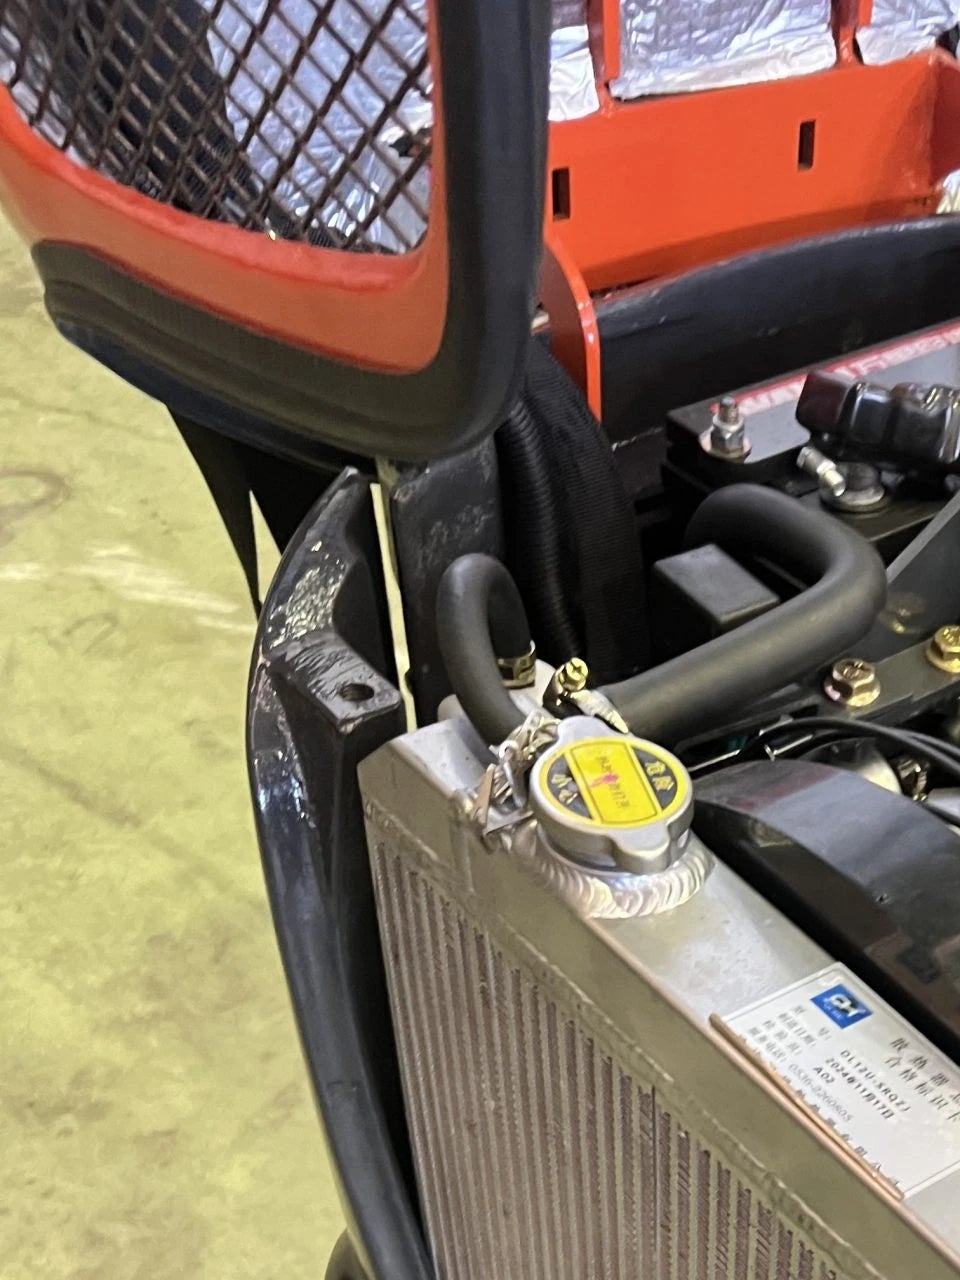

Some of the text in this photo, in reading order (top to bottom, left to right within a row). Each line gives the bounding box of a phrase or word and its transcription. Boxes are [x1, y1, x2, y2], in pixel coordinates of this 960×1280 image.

[812, 1066, 836, 1085] A02
[824, 1057, 896, 1120] 2024年11月17日
